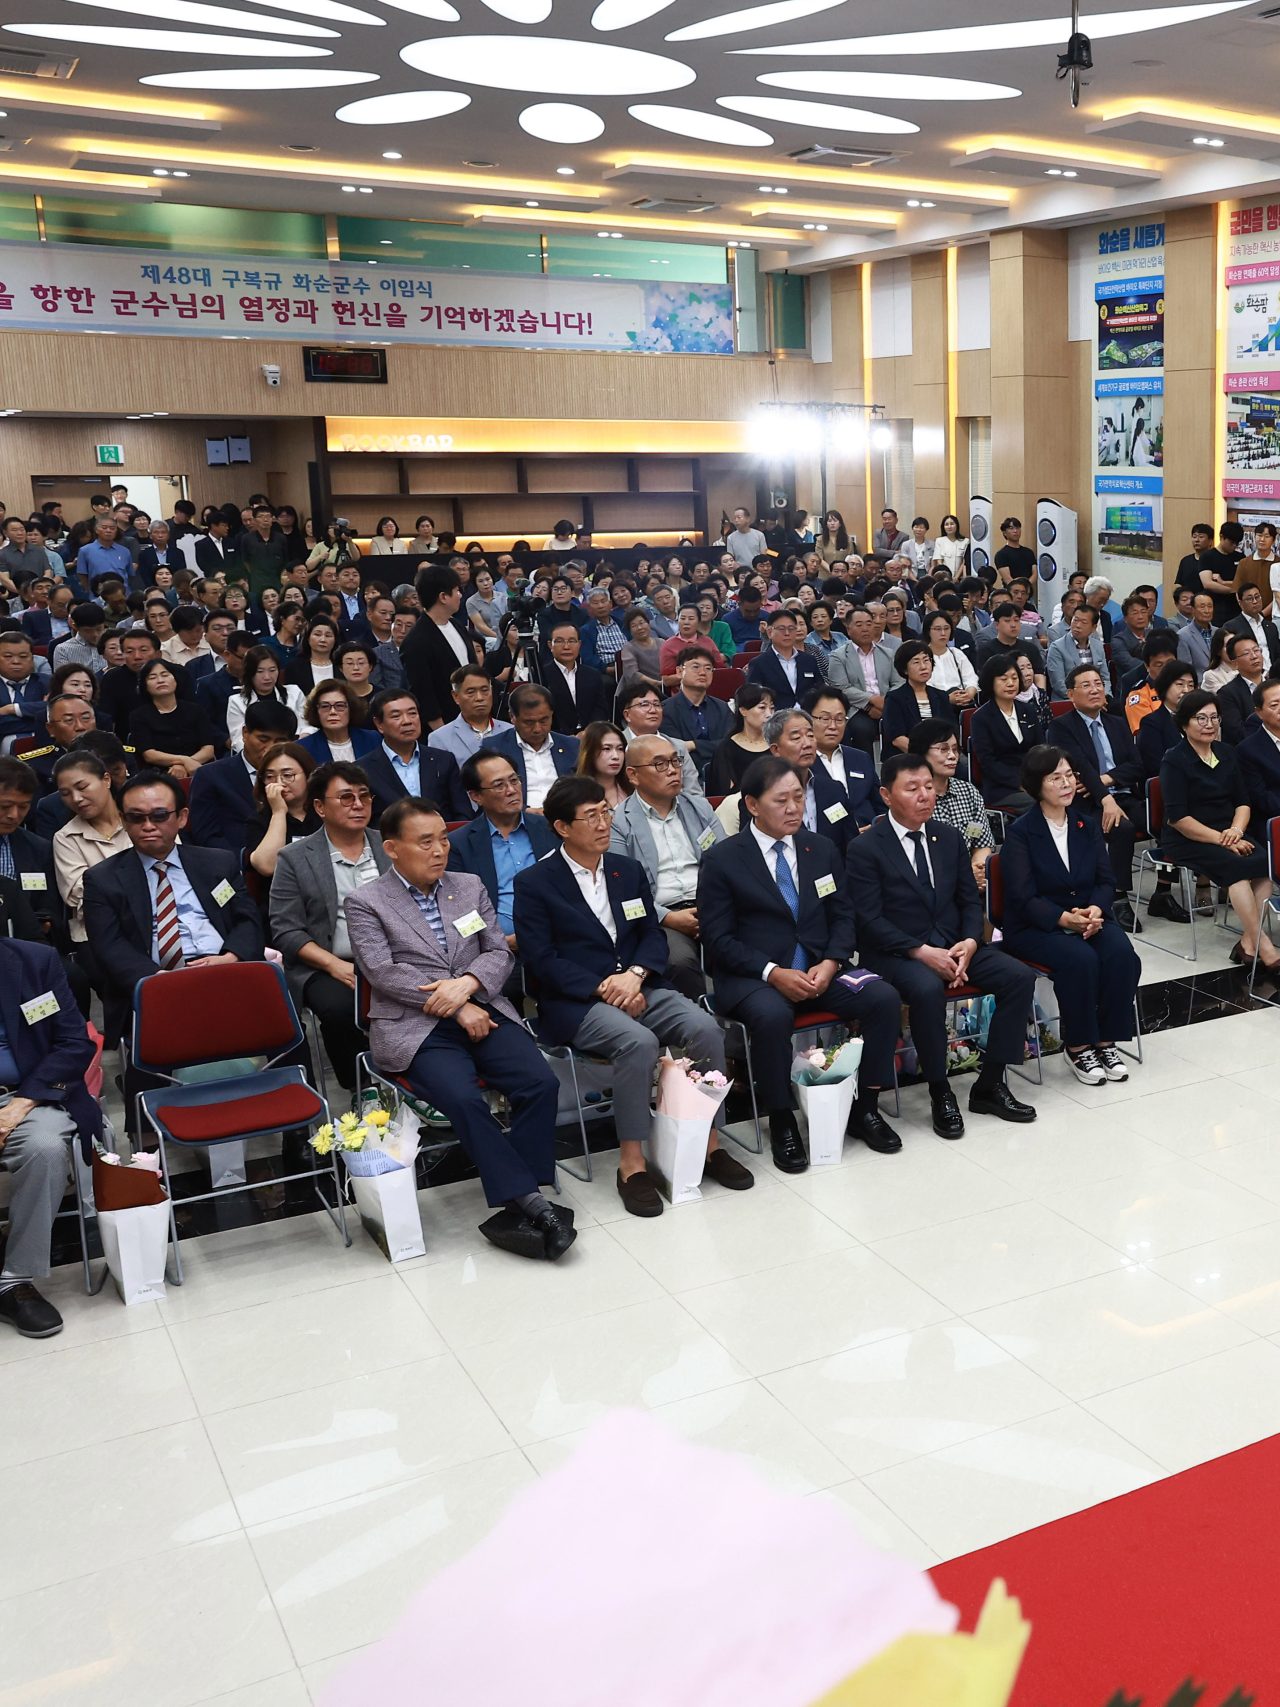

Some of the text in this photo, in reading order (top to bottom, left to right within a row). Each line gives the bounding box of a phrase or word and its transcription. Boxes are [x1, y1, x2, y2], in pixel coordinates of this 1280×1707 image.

[1231, 206, 1263, 235] 군민을
[1099, 228, 1130, 254] 화순을
[141, 264, 432, 298] 제48대 구복규 화순군수 이임식
[30, 284, 96, 314] 향한
[111, 290, 225, 320] 군수님의
[239, 296, 318, 324] 열정과
[332, 300, 408, 328] 헌신을
[420, 306, 593, 336] 기억하겠습니다!
